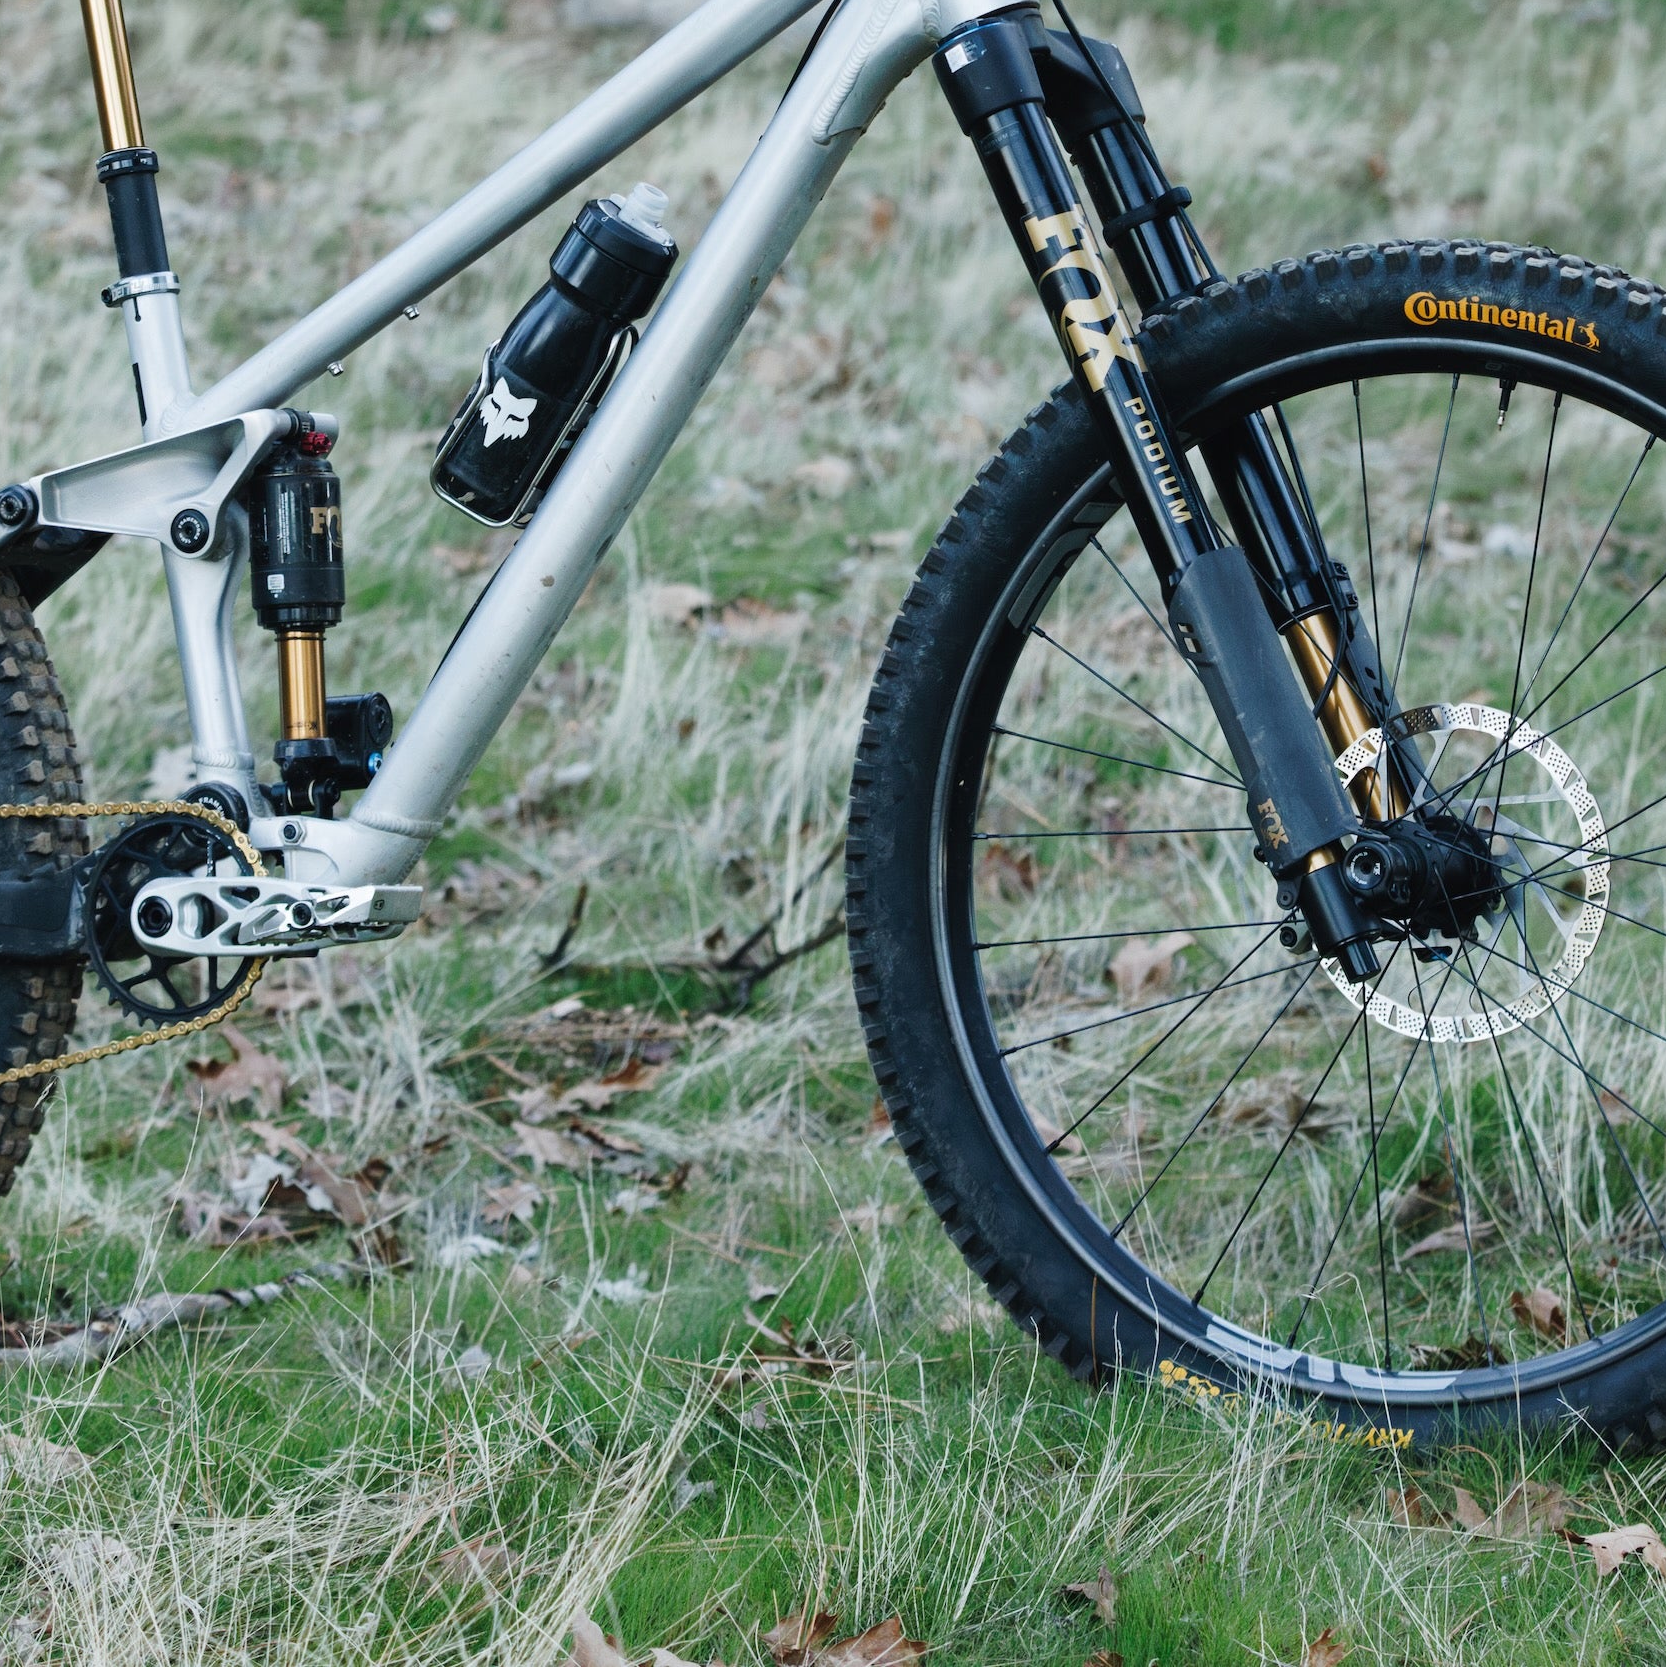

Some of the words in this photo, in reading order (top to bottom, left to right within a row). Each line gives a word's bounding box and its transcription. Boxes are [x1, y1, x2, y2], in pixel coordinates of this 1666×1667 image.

[1024, 203, 1149, 393] FOX
[1404, 291, 1576, 344] Continental
[1124, 396, 1193, 524] PODIUM
[310, 506, 343, 549] FO
[1257, 797, 1289, 850] FOX
